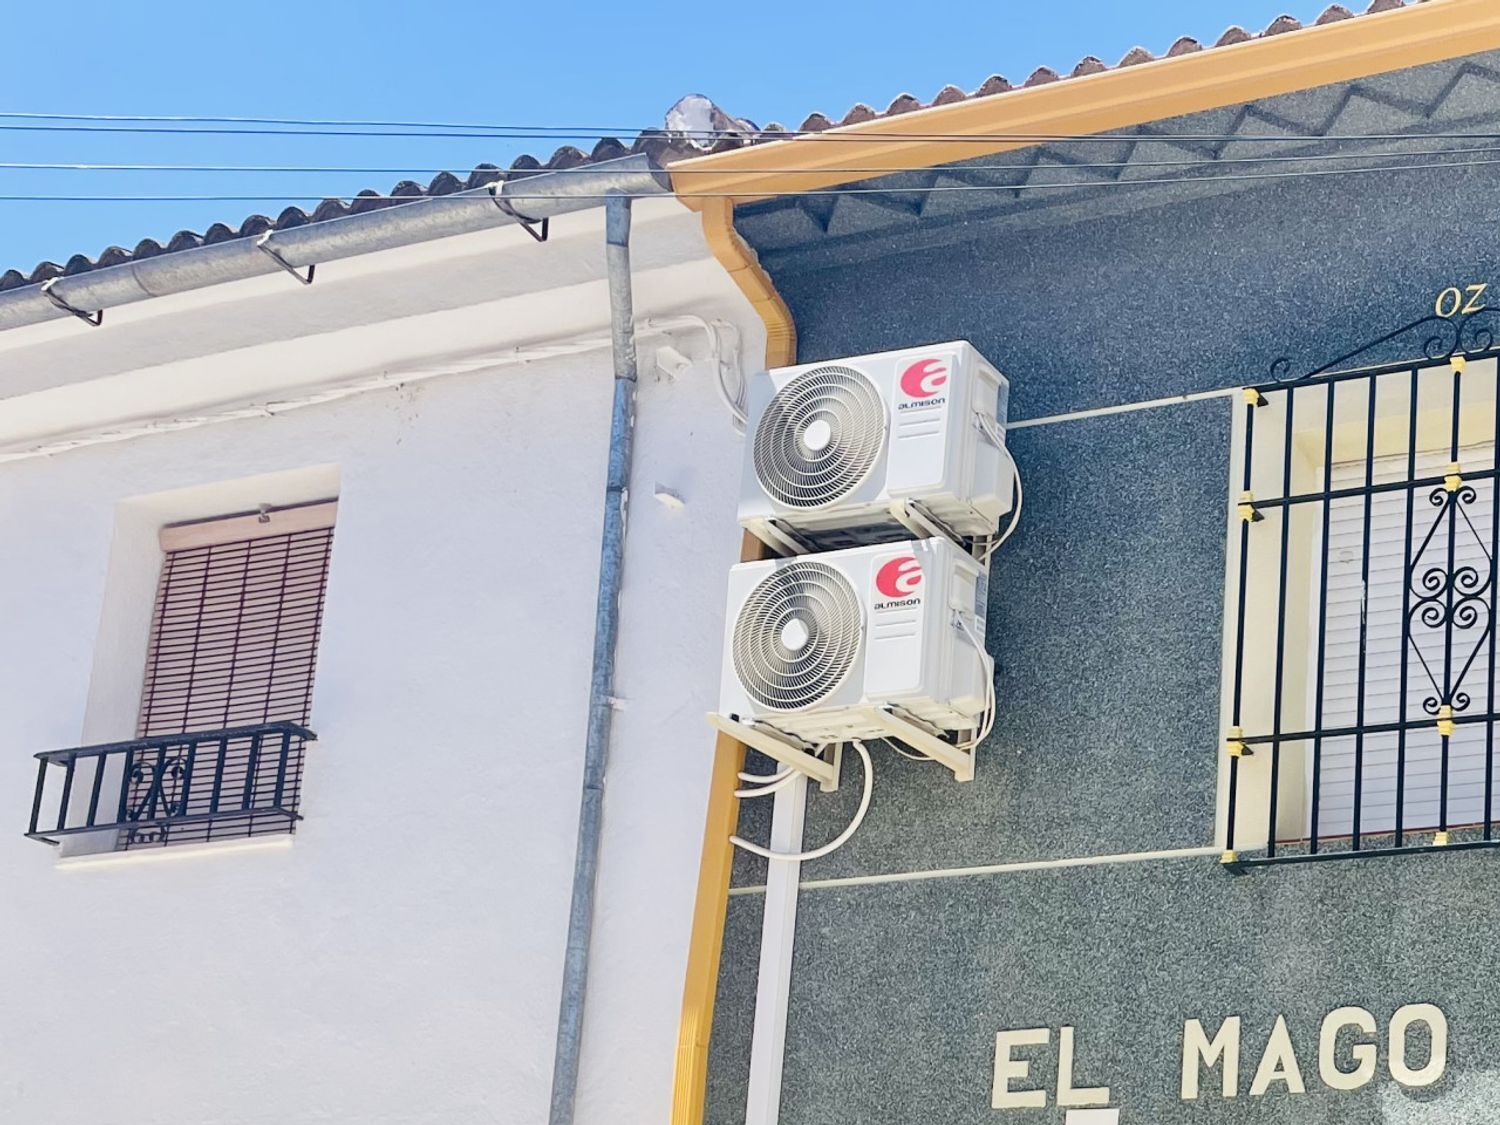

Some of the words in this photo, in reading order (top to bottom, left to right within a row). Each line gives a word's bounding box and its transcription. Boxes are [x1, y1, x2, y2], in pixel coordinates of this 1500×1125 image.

[1435, 282, 1488, 318] OZ
[991, 1026, 1110, 1109] EL
[1181, 1003, 1448, 1100] MAGO
